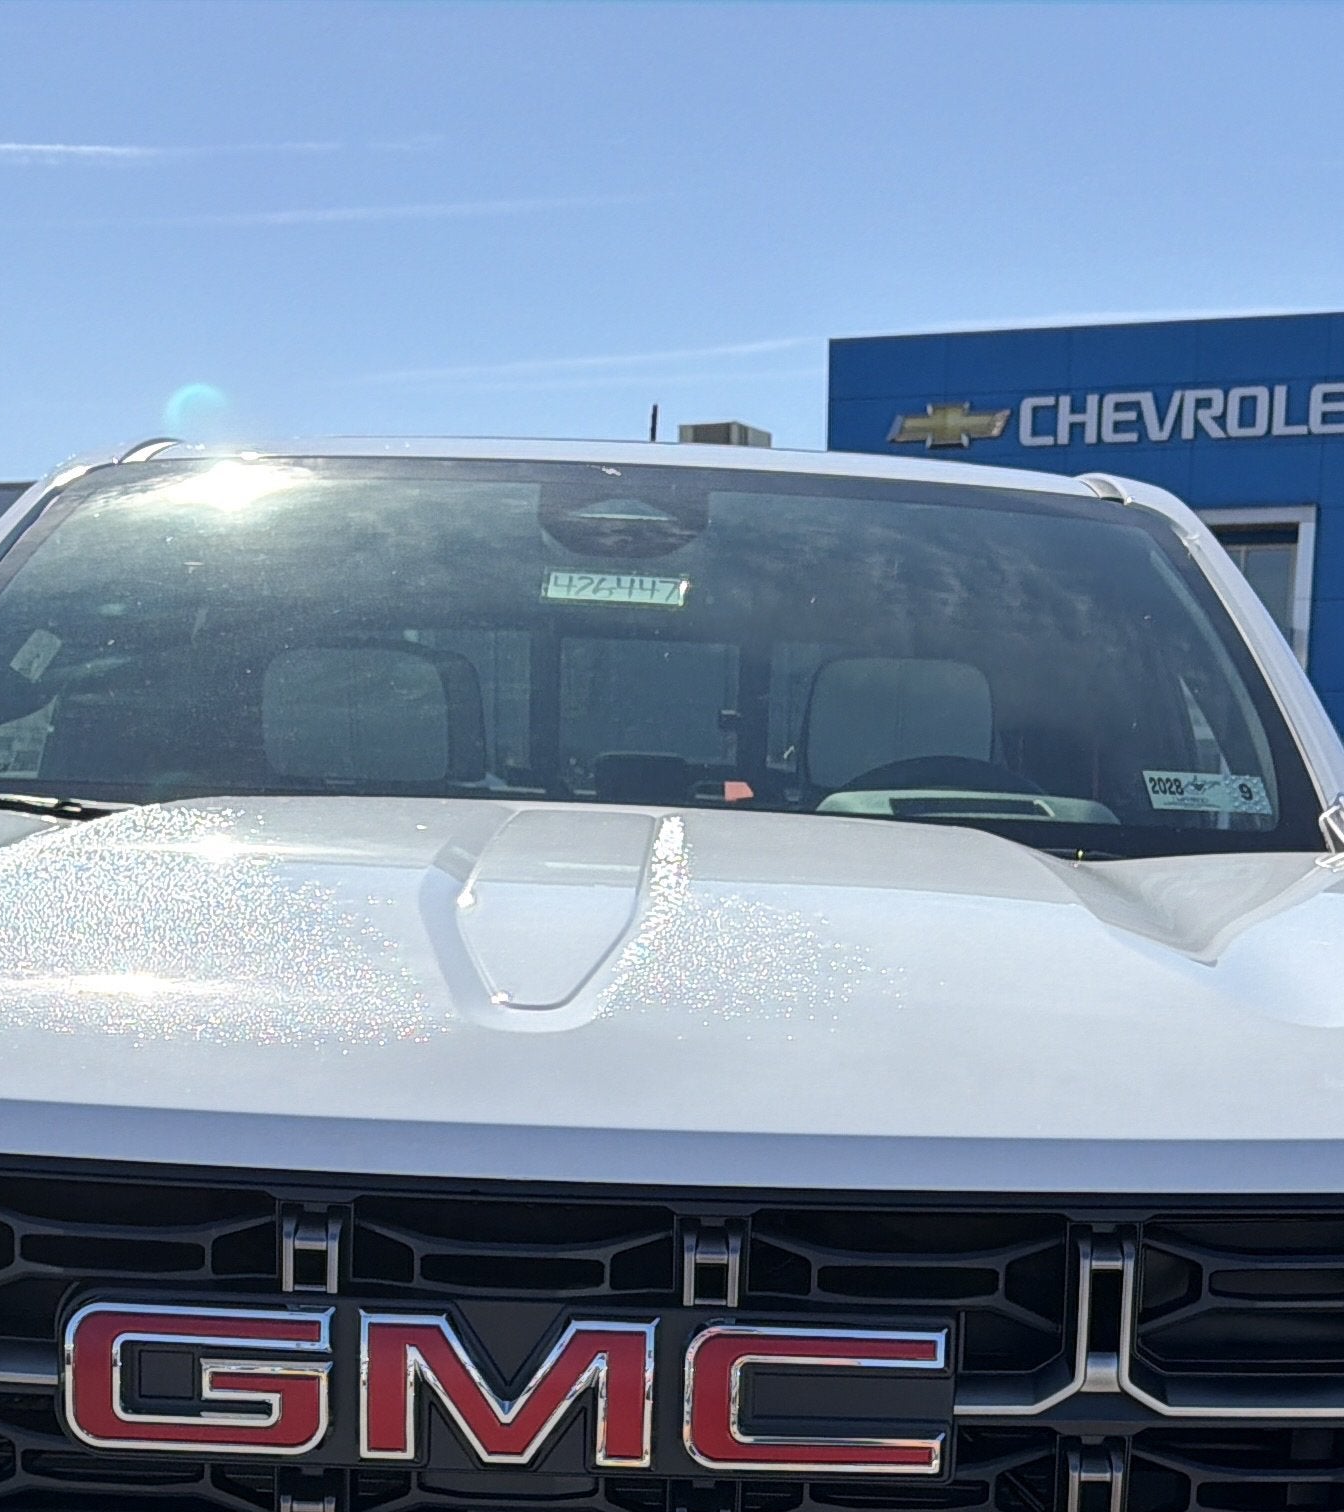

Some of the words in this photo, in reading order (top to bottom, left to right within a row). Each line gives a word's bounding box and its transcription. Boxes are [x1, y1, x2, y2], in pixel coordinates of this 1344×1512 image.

[553, 574, 679, 602] 426447
[1148, 776, 1185, 796] 2028
[1238, 783, 1254, 801] 9
[64, 1302, 948, 1474] GMC
